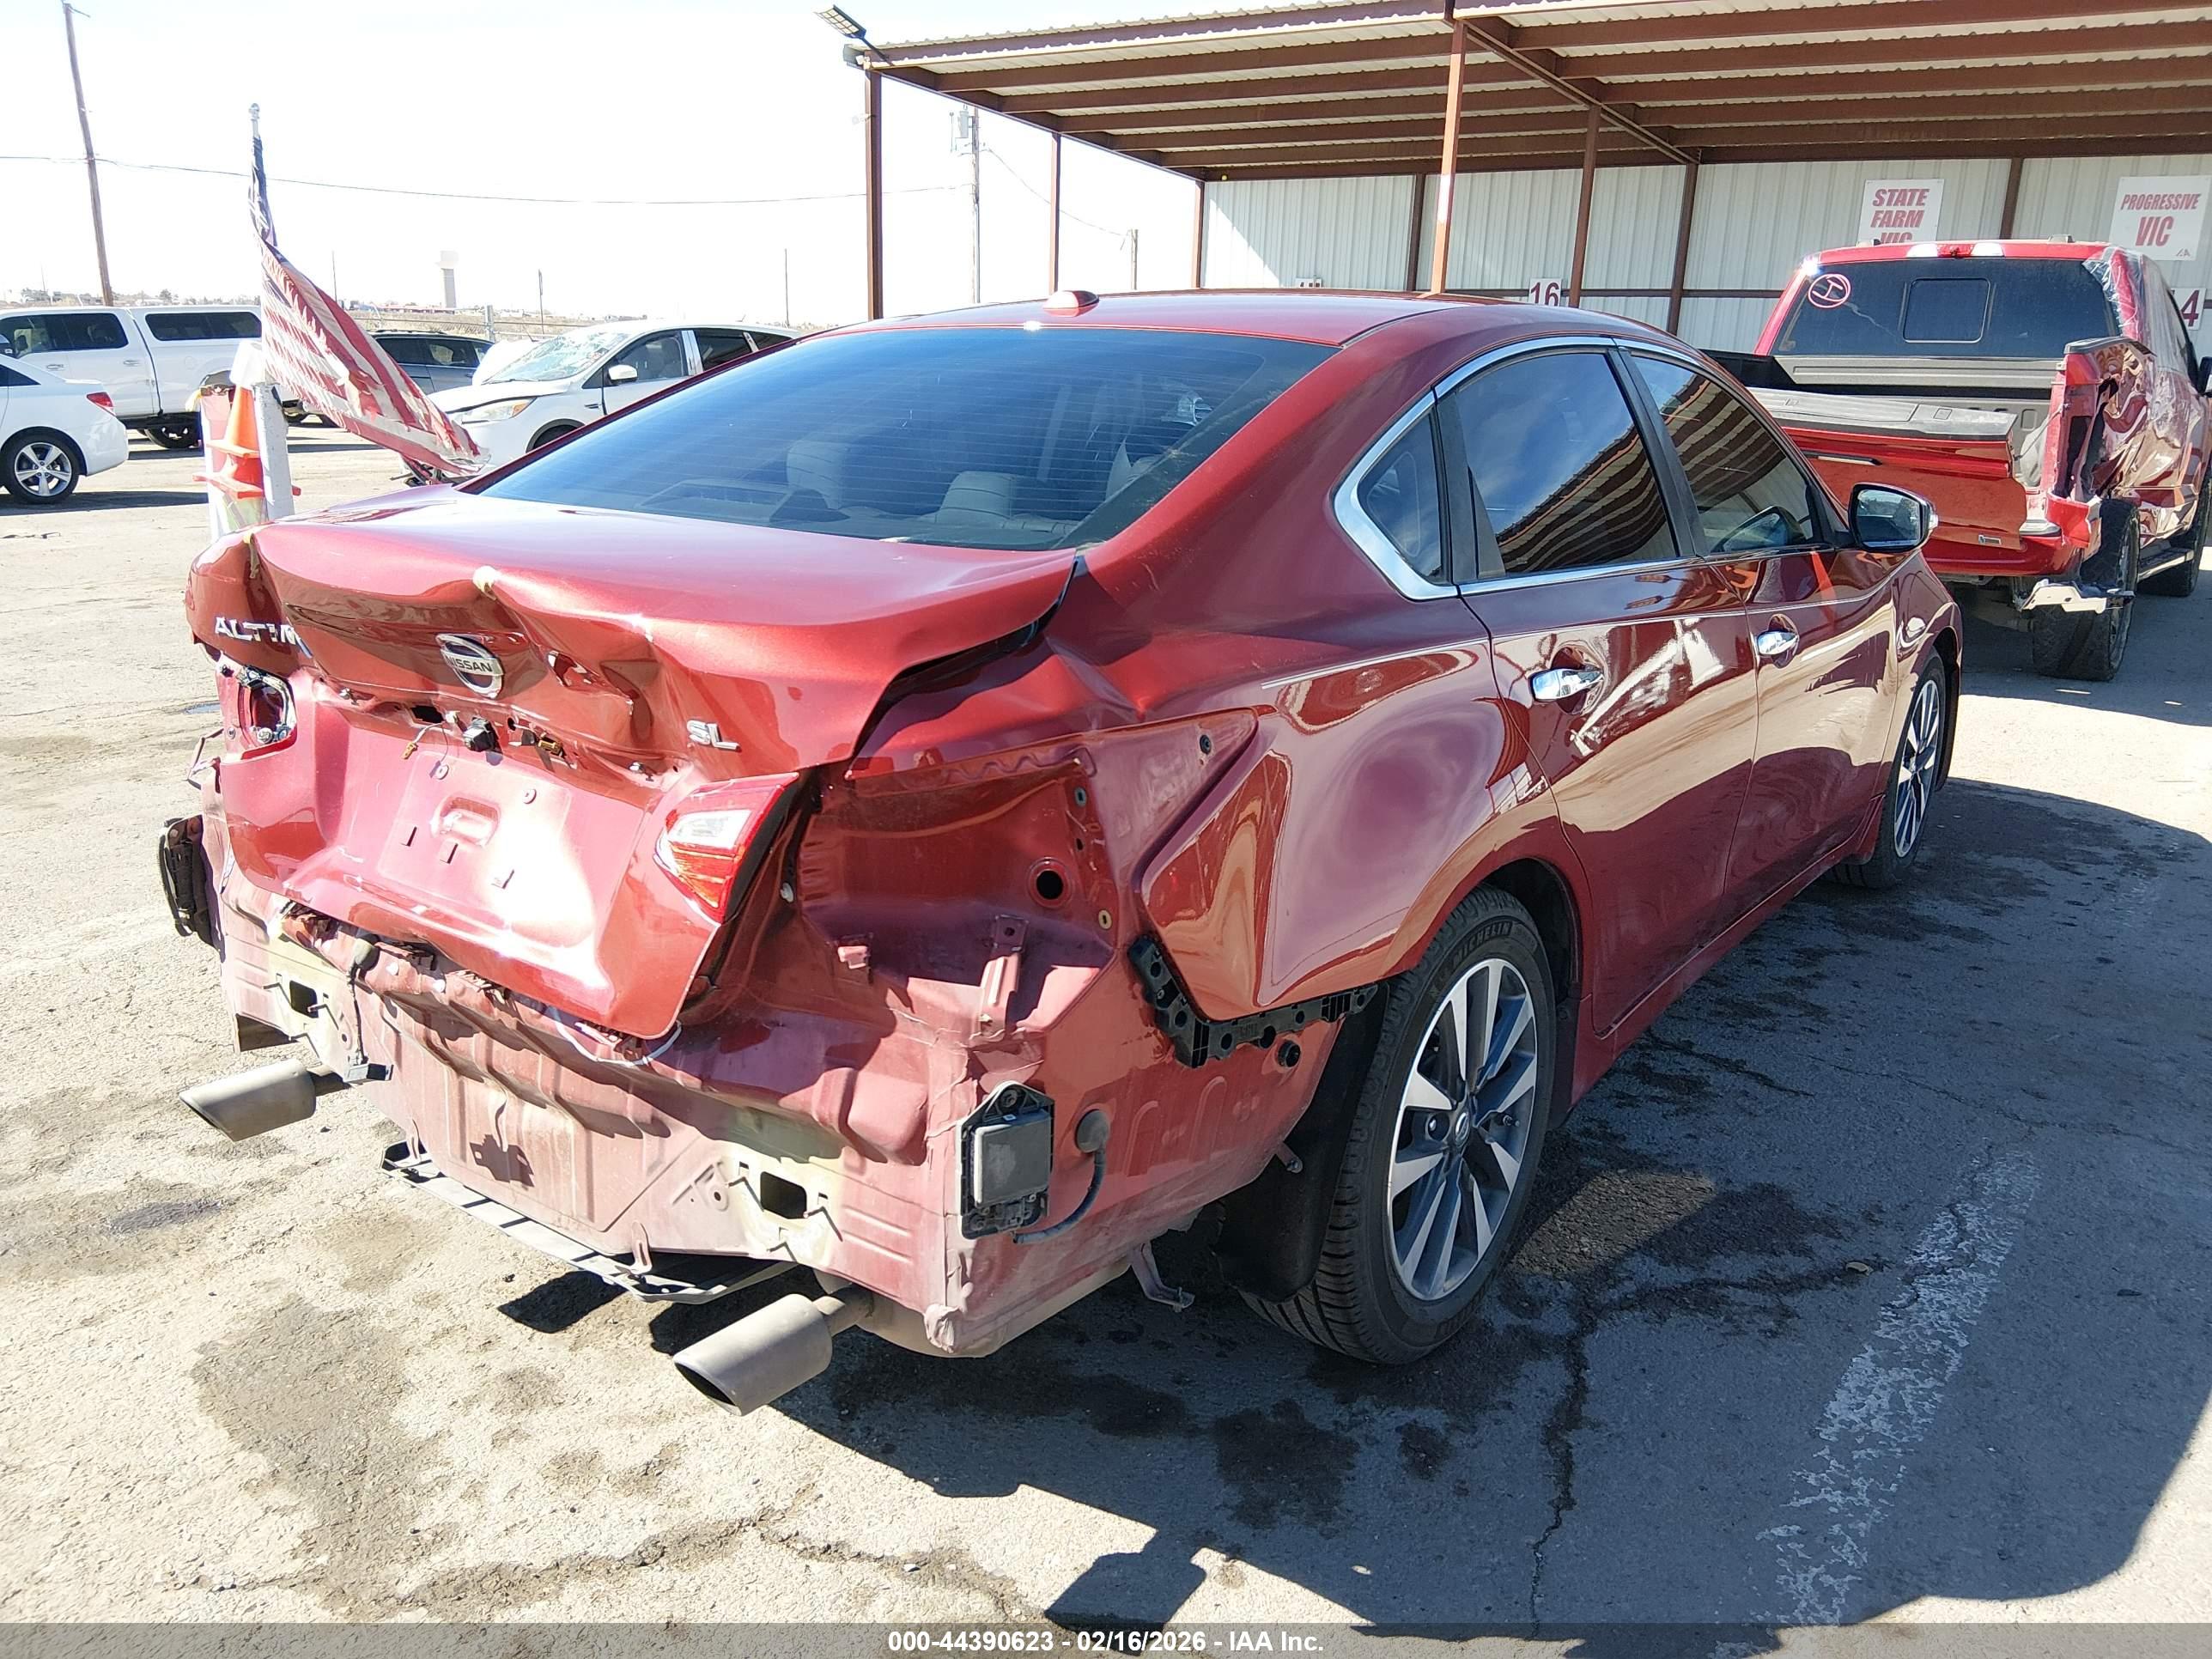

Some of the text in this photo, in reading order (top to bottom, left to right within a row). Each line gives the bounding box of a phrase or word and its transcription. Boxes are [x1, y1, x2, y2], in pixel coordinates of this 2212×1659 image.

[1872, 188, 1930, 207] STATE
[2120, 193, 2202, 210] PROGRESSIVE
[1870, 210, 1924, 228] FARM
[2134, 216, 2174, 246] VIC
[1530, 281, 1559, 307] 16
[2170, 289, 2199, 327] 4
[447, 655, 493, 672] NISSAN
[686, 720, 741, 751] SL
